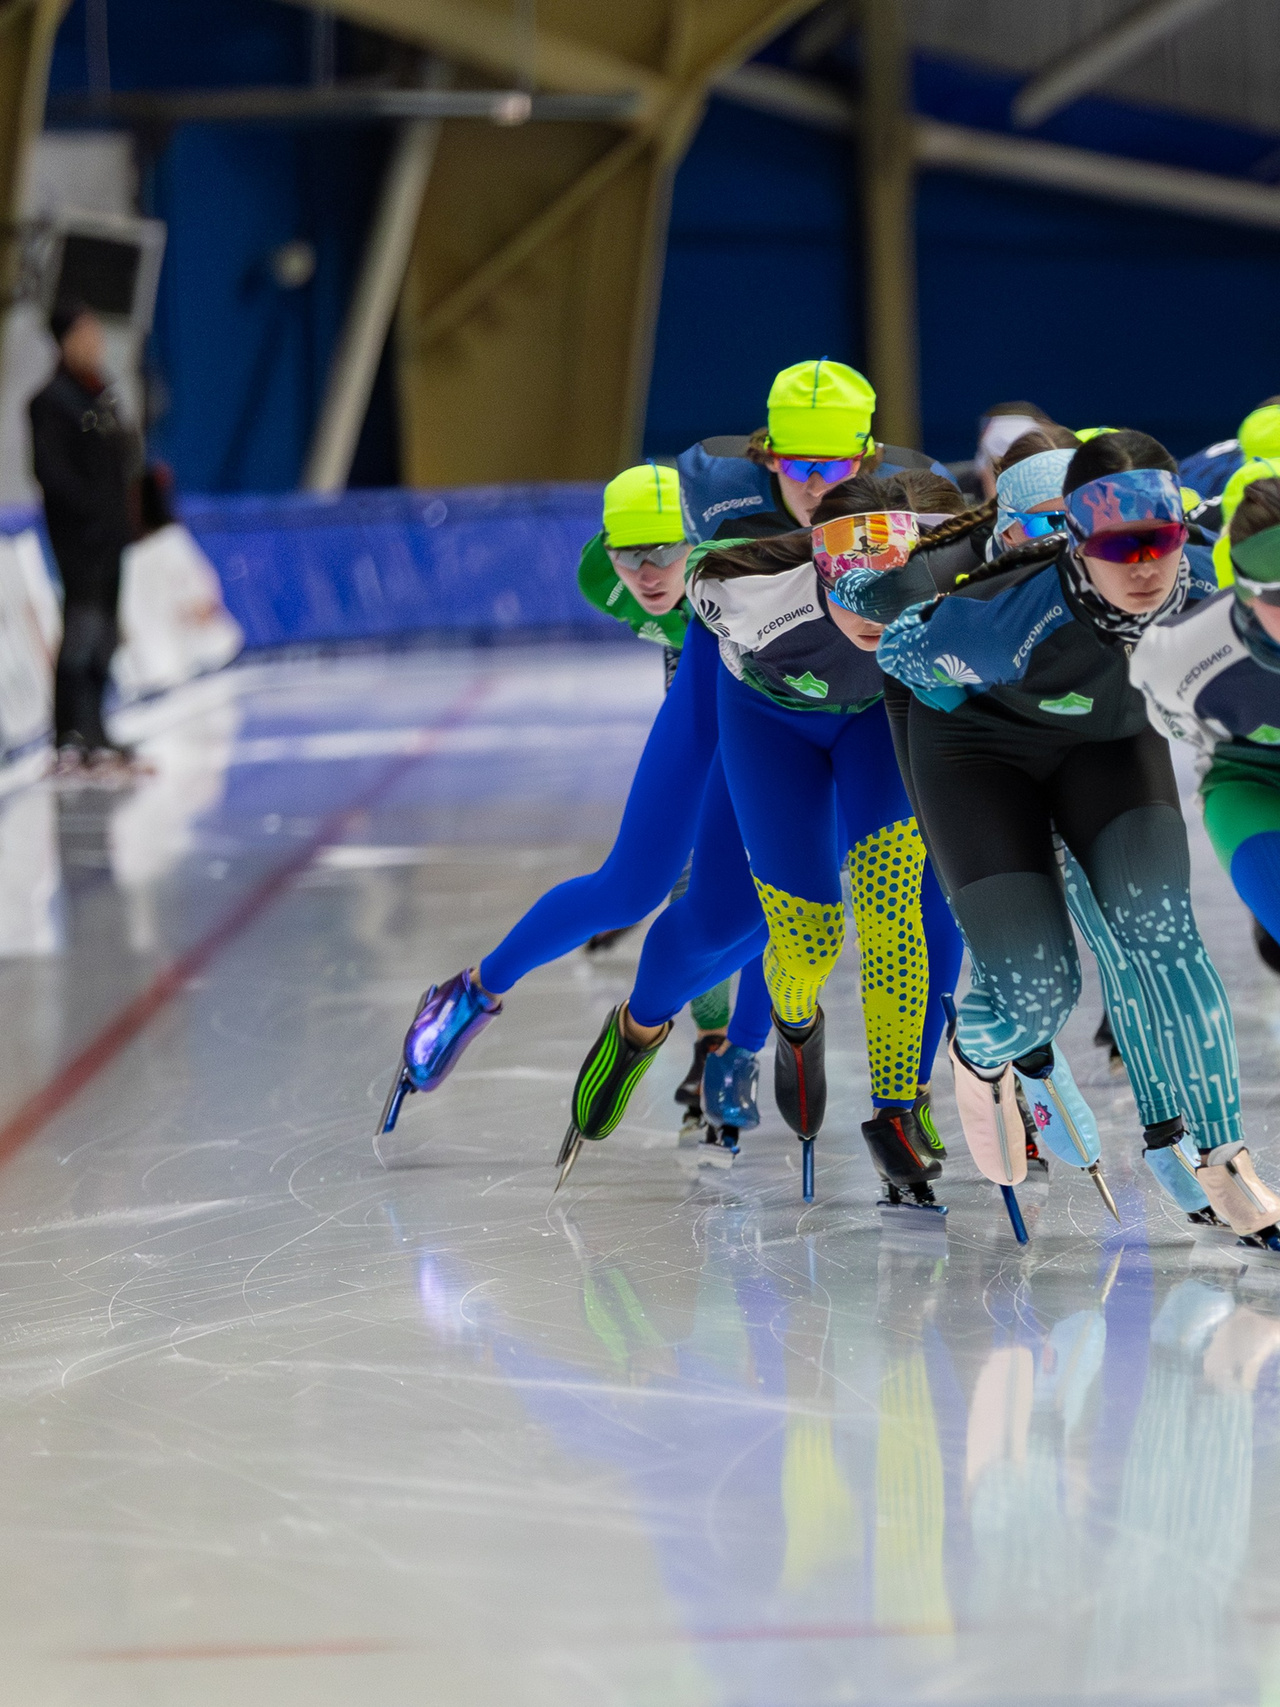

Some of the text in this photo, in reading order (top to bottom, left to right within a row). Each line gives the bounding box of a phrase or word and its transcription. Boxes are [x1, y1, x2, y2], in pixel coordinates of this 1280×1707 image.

[762, 603, 814, 635] сервико
[1018, 605, 1063, 658] сервико
[1180, 644, 1233, 693] сервико
